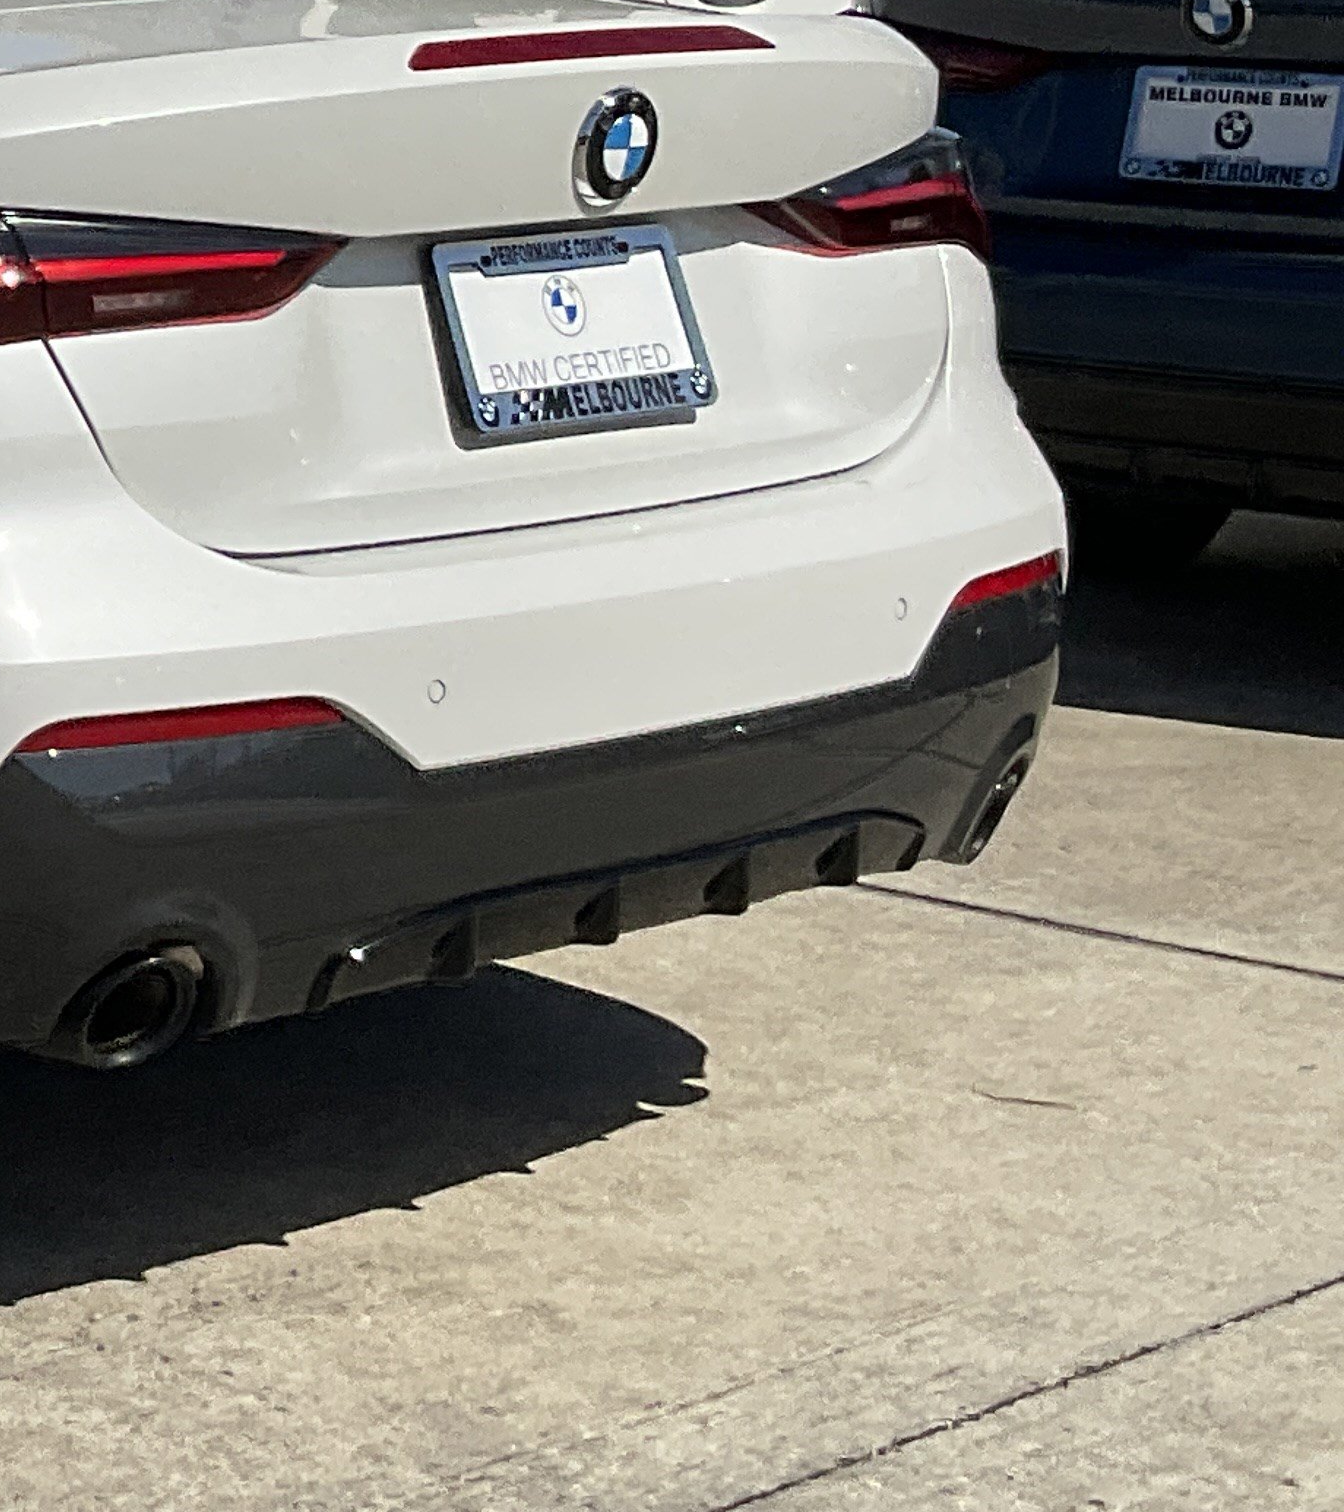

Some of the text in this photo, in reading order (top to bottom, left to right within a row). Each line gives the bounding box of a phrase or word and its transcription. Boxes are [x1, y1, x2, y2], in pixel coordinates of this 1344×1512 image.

[1149, 86, 1328, 108] MELBOURNE BMW
[489, 235, 619, 267] PERFORMANCE COUNTS
[489, 343, 671, 390] BMW CERTIFIED
[542, 373, 687, 420] MELBOURNE
